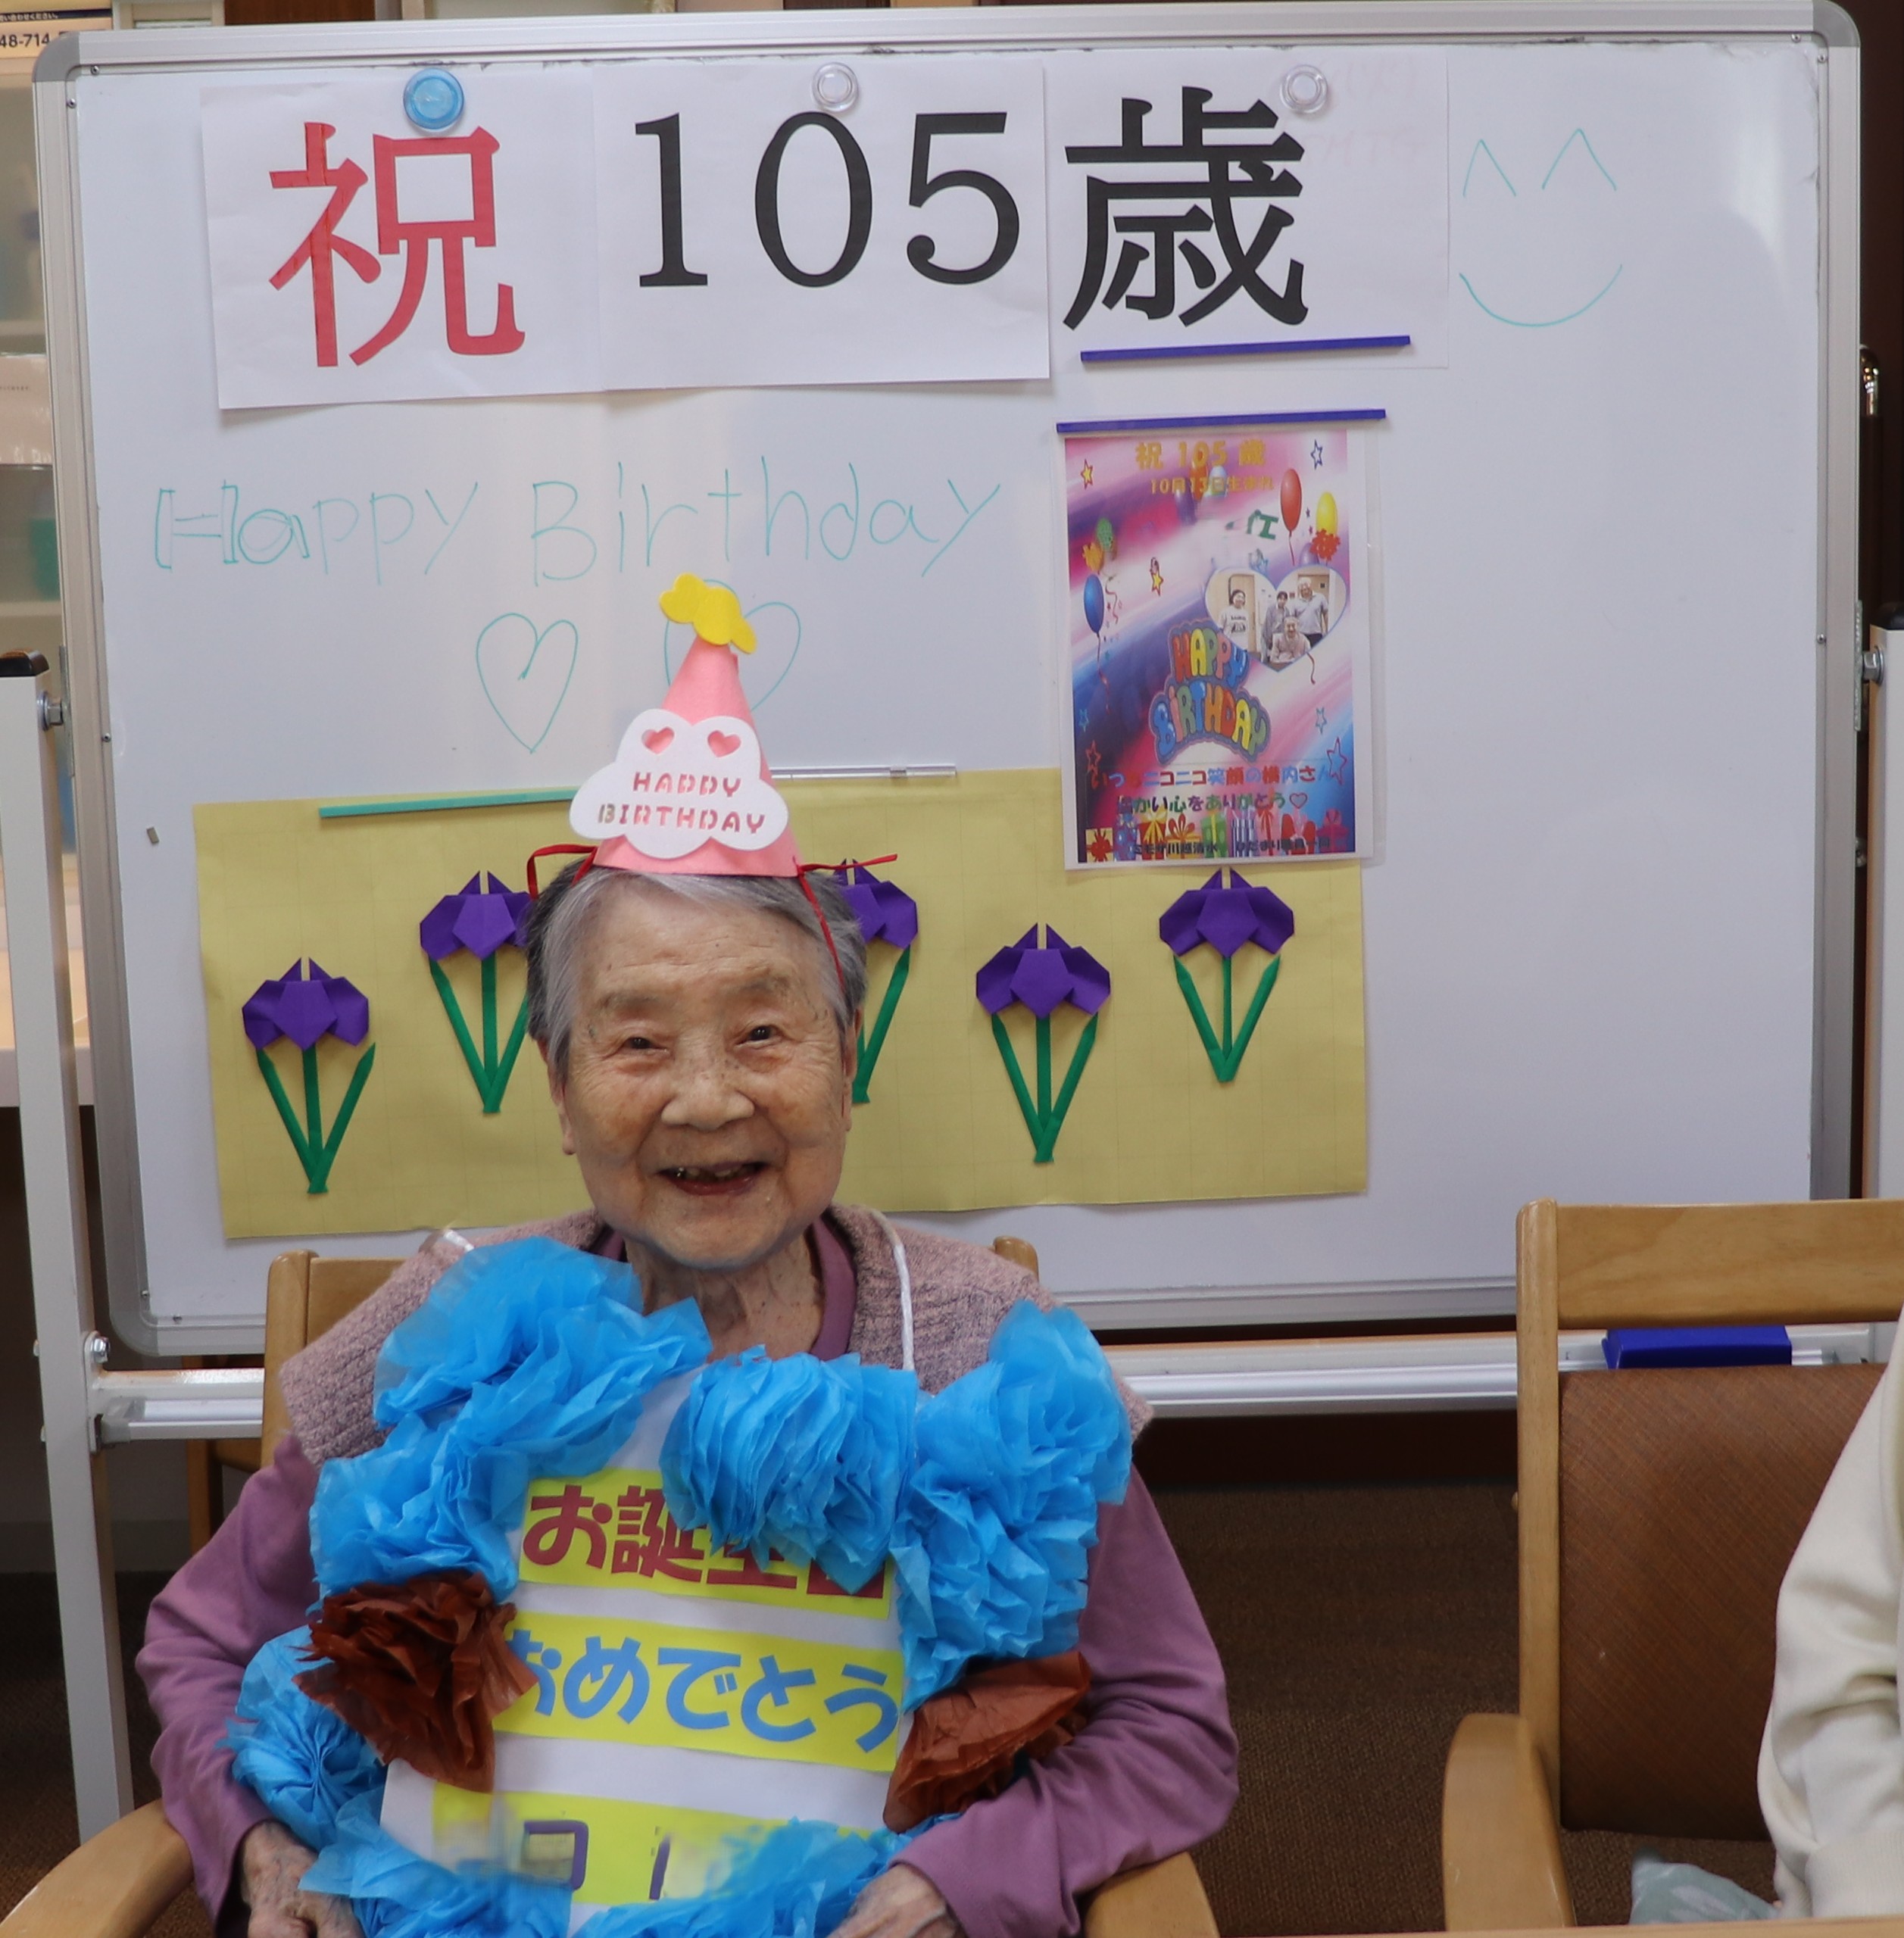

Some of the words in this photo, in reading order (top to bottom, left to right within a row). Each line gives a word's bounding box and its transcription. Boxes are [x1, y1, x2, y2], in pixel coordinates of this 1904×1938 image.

[268, 121, 526, 367] 祝
[1178, 441, 1228, 469] 105
[154, 479, 479, 586] Happy
[530, 455, 1000, 587] Birthday
[1172, 628, 1248, 685] HAPPY
[598, 803, 765, 834] BIRTHDAY
